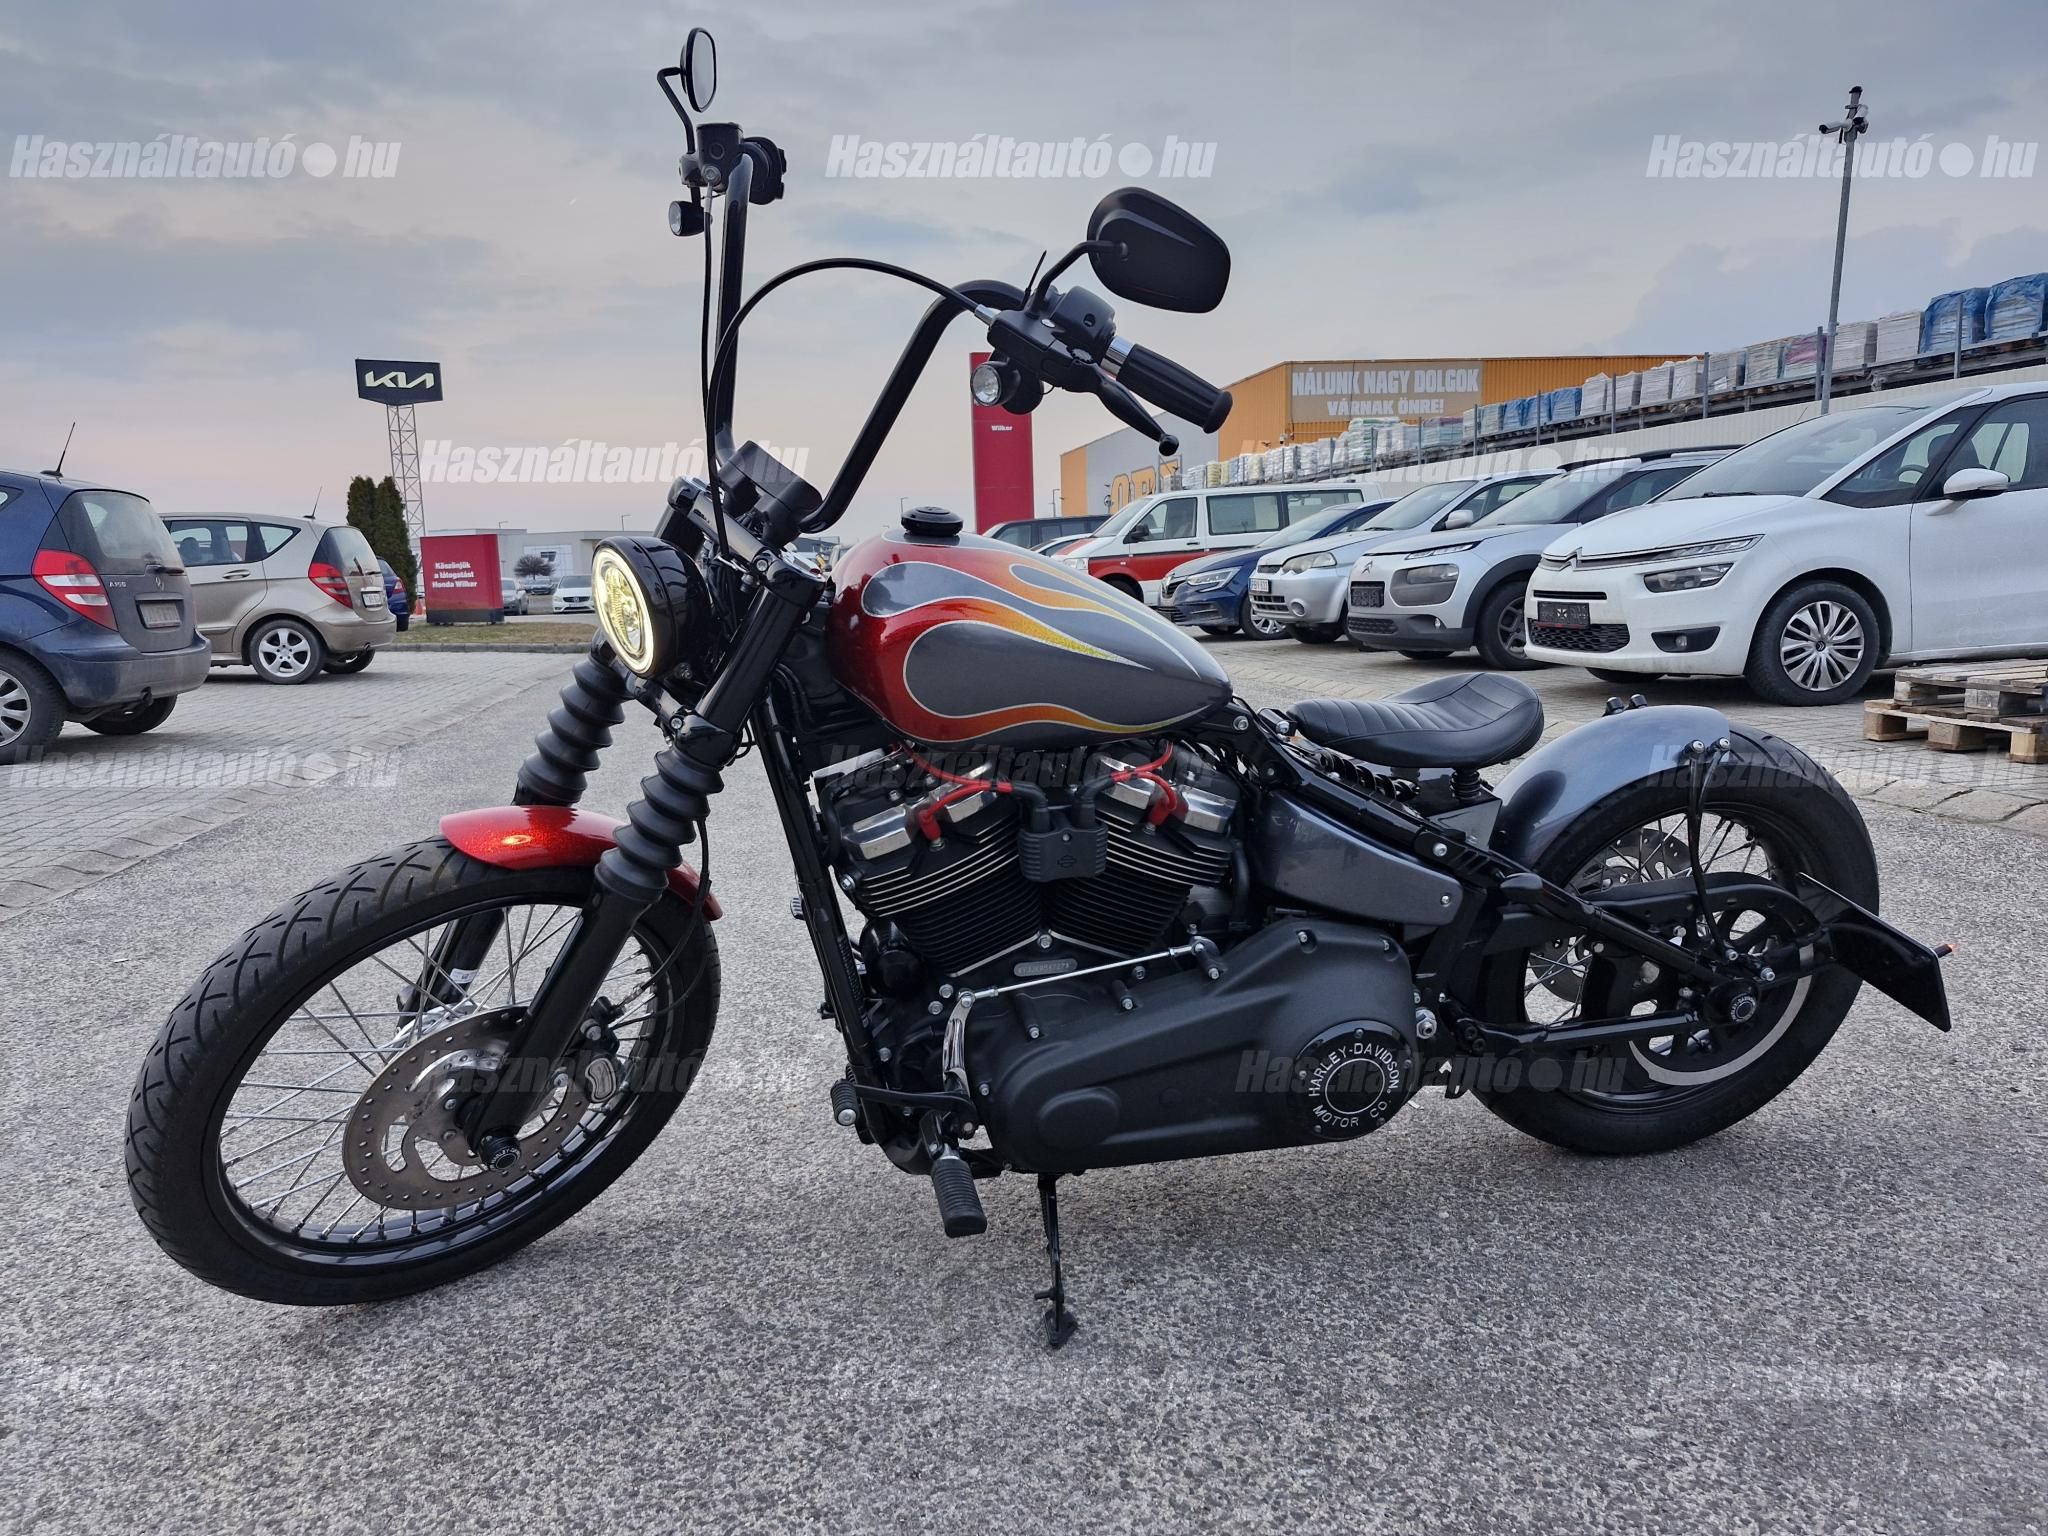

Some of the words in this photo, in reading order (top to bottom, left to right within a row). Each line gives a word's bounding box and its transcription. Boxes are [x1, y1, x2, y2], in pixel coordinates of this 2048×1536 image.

[364, 371, 435, 389] KIA
[1292, 368, 1361, 396] NÁLUNK
[1363, 370, 1410, 394] NAGY
[1414, 368, 1479, 393] DOLGOK
[1327, 398, 1395, 416] VÁRNAK
[1398, 398, 1444, 414] ÖNRE!
[1308, 1043, 1400, 1097] HARLEY-DAVIDSON
[1313, 1104, 1359, 1128] MOTOR
